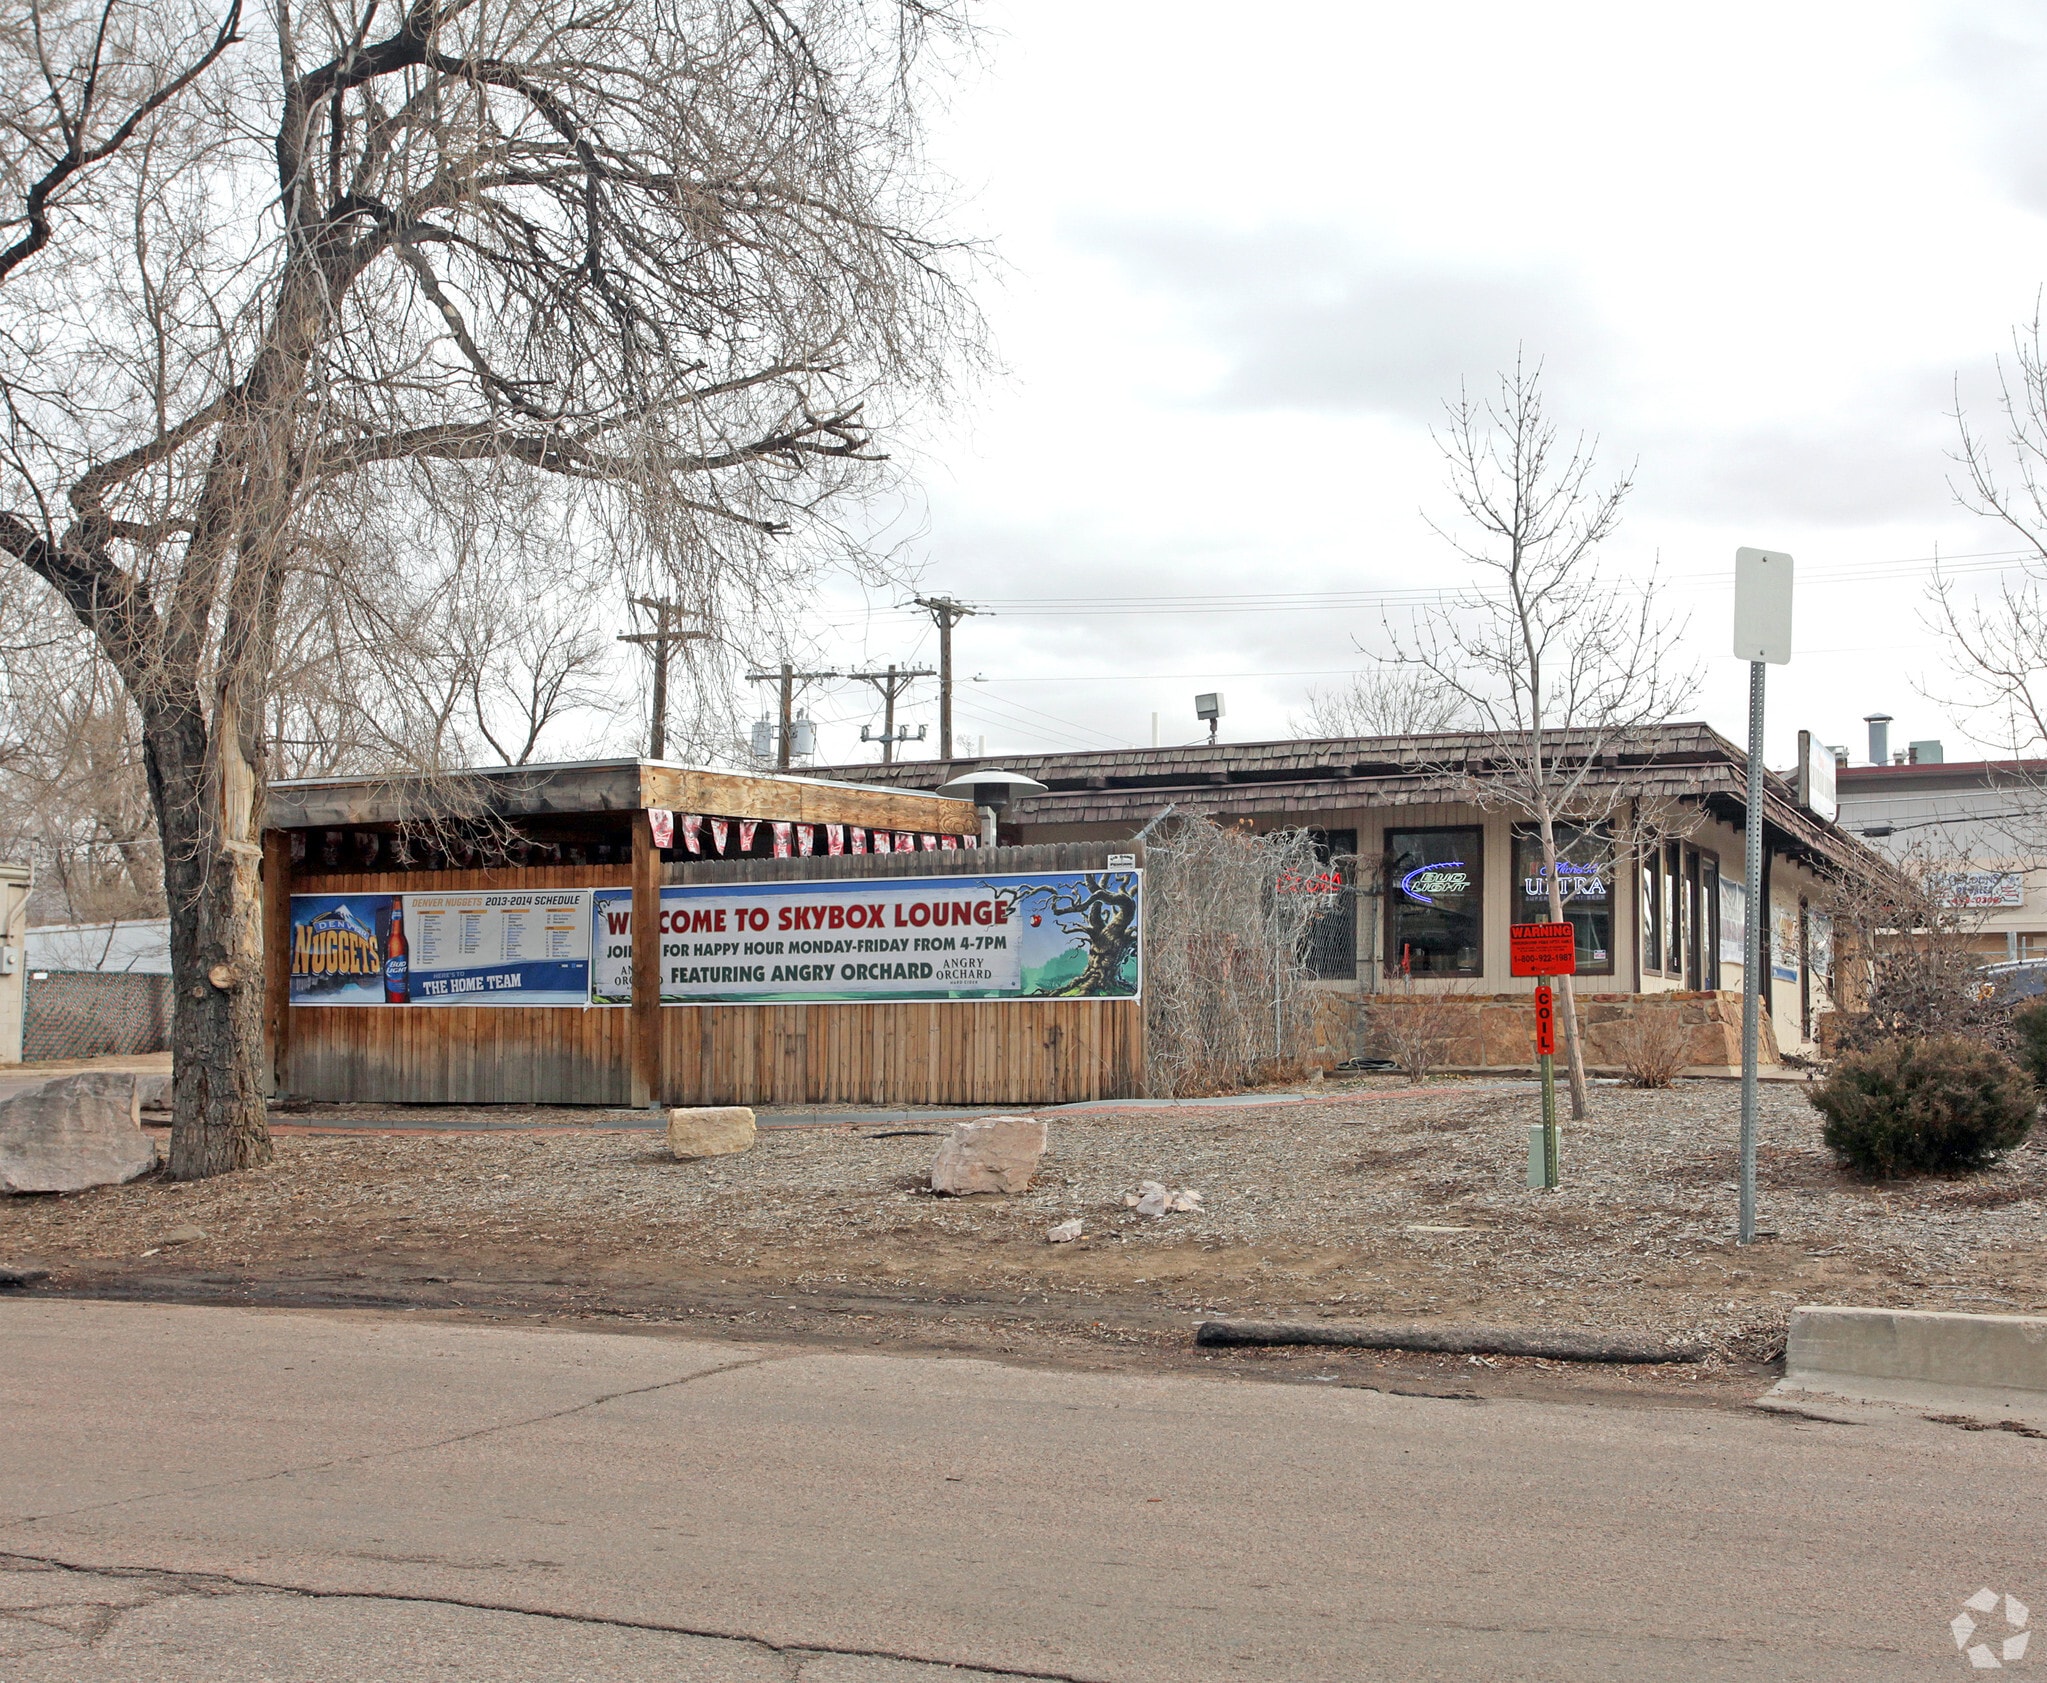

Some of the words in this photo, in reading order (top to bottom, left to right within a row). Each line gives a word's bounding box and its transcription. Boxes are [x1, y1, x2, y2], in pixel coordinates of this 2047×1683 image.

[1421, 872, 1467, 883] BUD
[1411, 881, 1471, 892] LIGHT
[412, 898, 444, 908] DENVER
[445, 897, 483, 907] NUGGETS
[485, 896, 533, 906] 2013-2014
[534, 895, 580, 905] SCHEDULE
[607, 909, 726, 935] WCOME
[735, 907, 770, 932] TO
[778, 904, 886, 931] SKYBOX
[894, 900, 1008, 928] LOUNGE
[1511, 925, 1572, 938] WARNING
[292, 924, 380, 976] NUGGETS
[607, 945, 633, 958] JOI
[663, 944, 689, 957] FOR
[693, 942, 740, 956] HAPPY
[744, 941, 784, 955] HOUR
[788, 938, 909, 954] MONDAY-FRIDAY
[914, 937, 956, 951] FROM
[959, 936, 1007, 950] 4-7PM
[943, 957, 984, 969] ANGRY
[1514, 953, 1573, 963] 1-800-922-1987
[671, 966, 765, 984] FEATURING
[770, 964, 835, 981] ANGRY
[841, 962, 933, 980] ORCHARD
[936, 969, 992, 980] ORCHARD
[423, 980, 448, 995] THE
[450, 976, 485, 993] HOME
[486, 973, 522, 990] TEAM
[1538, 993, 1550, 1048] COIL
